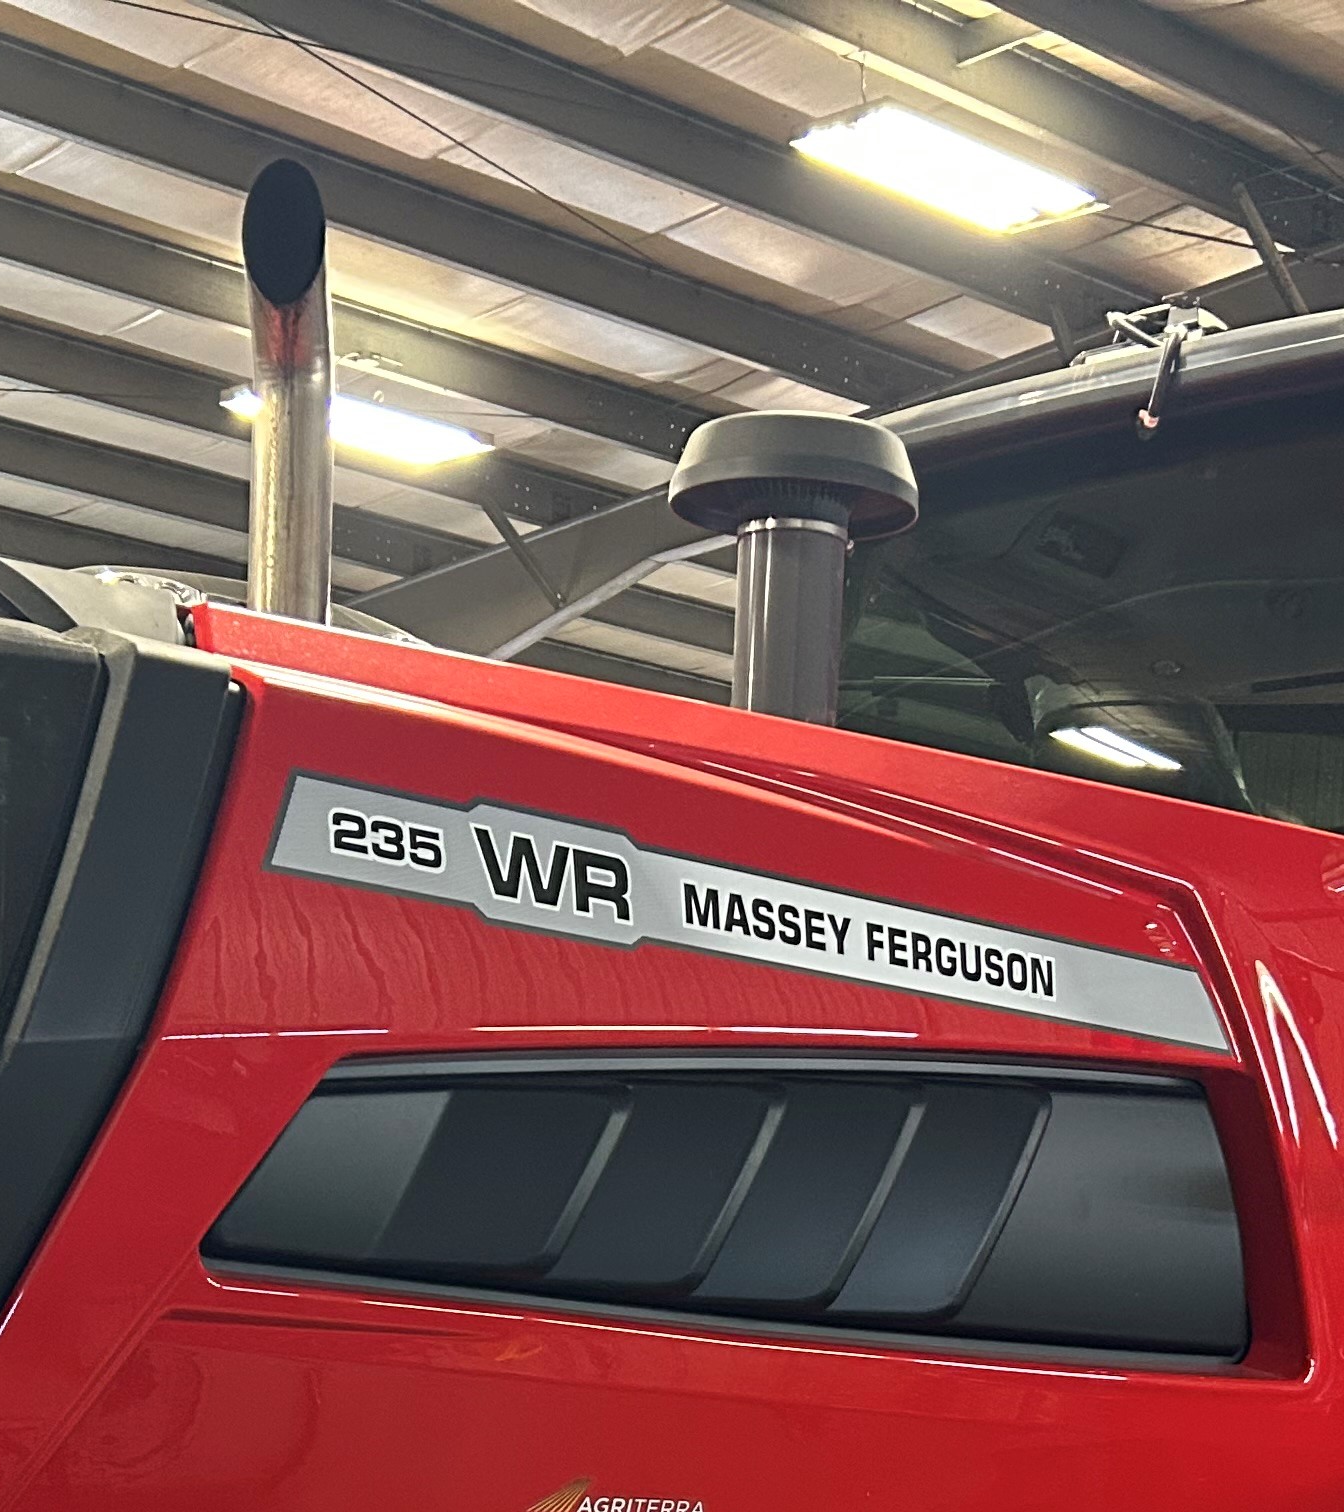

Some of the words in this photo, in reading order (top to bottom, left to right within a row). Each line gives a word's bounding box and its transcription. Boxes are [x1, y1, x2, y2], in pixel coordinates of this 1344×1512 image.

[330, 808, 444, 871] 235
[471, 823, 633, 925] WR
[681, 881, 851, 956] MASSEY
[864, 921, 1056, 998] FERGUSON
